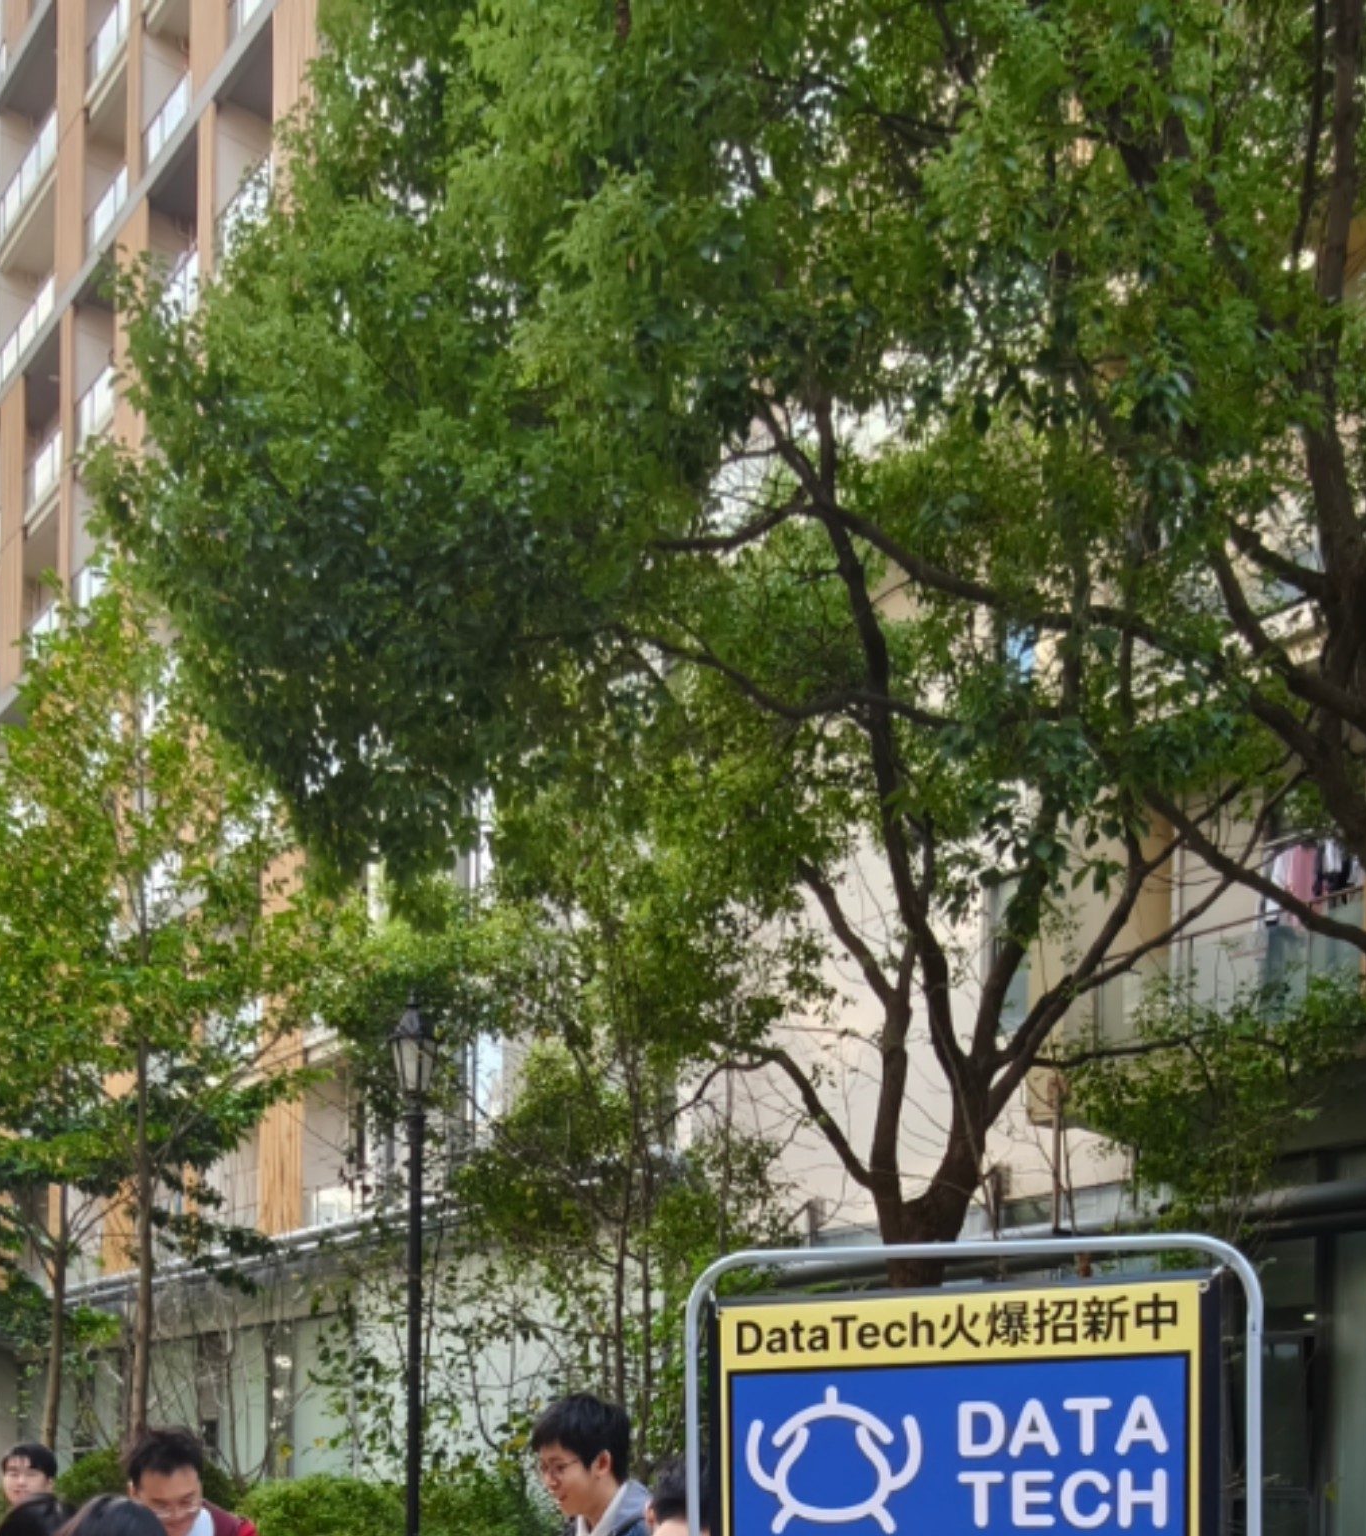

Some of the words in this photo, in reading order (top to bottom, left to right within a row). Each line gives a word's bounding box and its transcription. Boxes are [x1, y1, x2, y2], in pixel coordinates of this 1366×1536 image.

[735, 1293, 1180, 1356] DataTech火爆招新中
[958, 1395, 1168, 1458] DATA
[958, 1469, 1168, 1529] TECH
